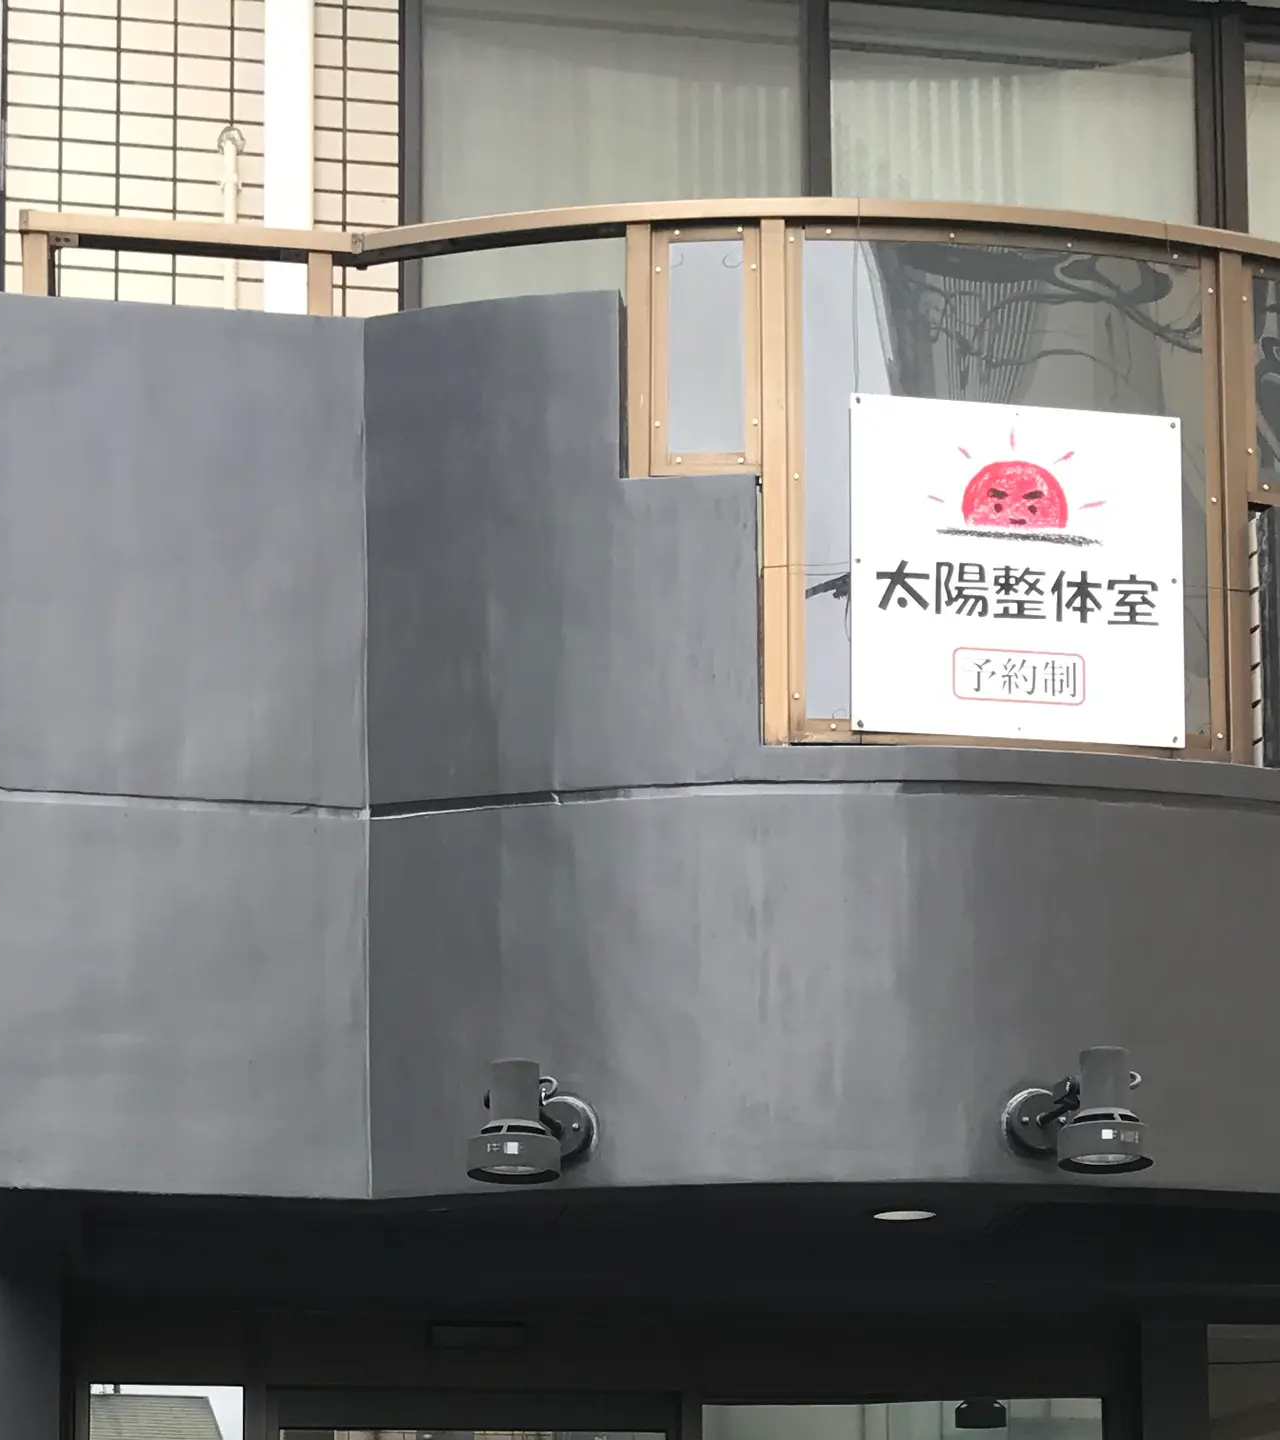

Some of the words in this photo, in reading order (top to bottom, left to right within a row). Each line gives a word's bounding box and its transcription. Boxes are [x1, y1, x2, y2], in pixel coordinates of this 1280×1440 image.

[876, 560, 1159, 626] 太陽整体室
[963, 657, 1077, 698] 予約制
